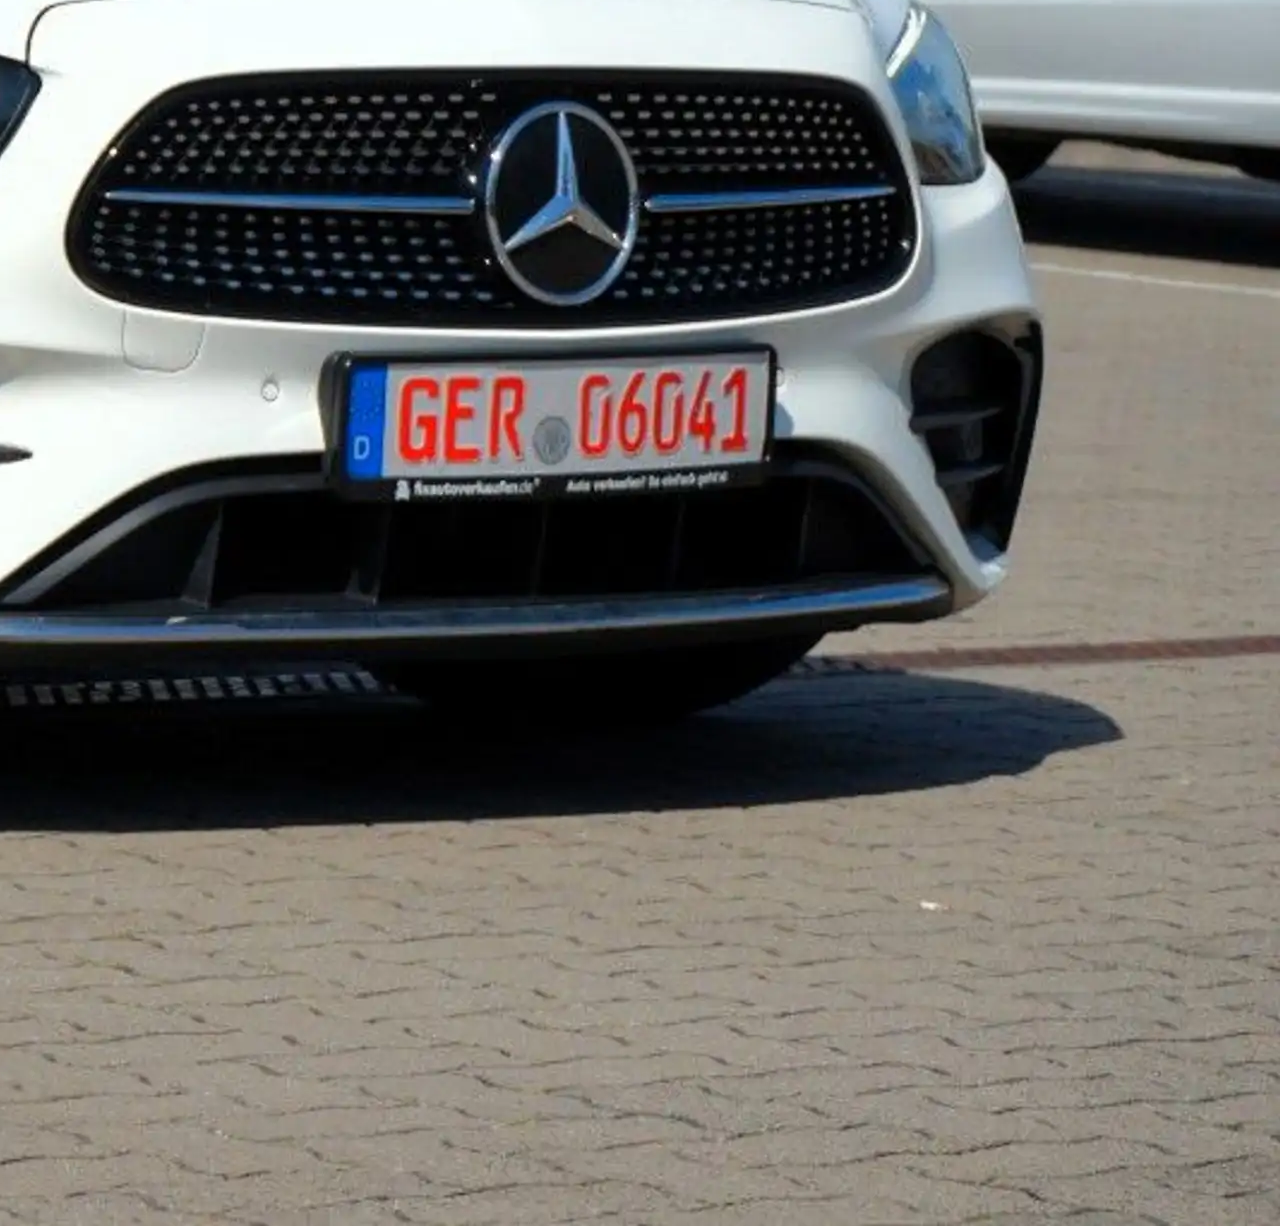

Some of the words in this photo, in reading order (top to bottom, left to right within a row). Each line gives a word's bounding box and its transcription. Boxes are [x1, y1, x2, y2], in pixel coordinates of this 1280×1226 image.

[397, 376, 527, 464] GER
[578, 367, 748, 456] 06041
[353, 436, 370, 460] D
